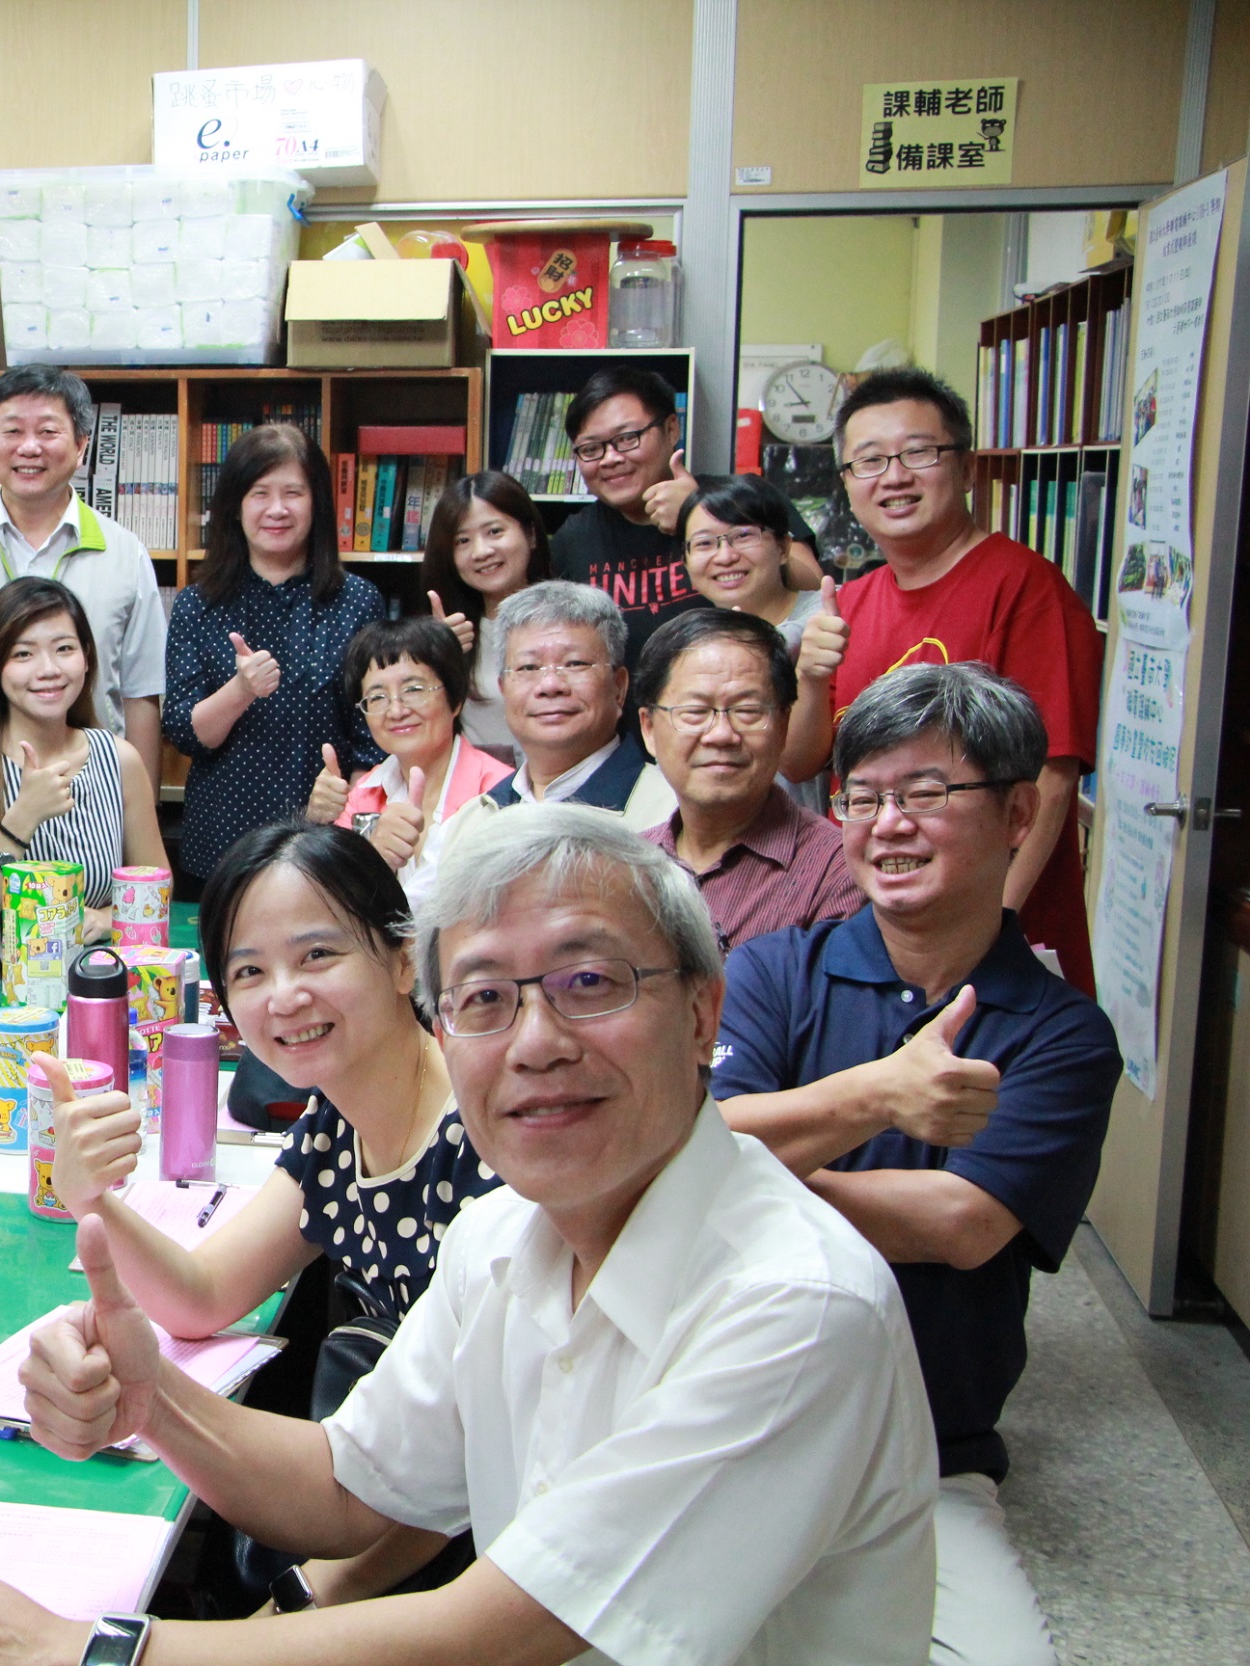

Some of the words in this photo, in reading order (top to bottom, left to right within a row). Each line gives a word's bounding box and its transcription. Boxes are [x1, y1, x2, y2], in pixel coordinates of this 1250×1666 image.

[169, 74, 276, 109] 跳蚤市場
[883, 86, 1004, 118] 課輔老師
[199, 149, 249, 163] paper
[896, 141, 986, 171] 備課室
[543, 252, 572, 283] 招財
[506, 286, 594, 337] LUCKY
[101, 415, 118, 433] THE
[99, 434, 117, 465] WORLD
[589, 560, 699, 606] UNITE
[139, 1025, 160, 1035] OTTE
